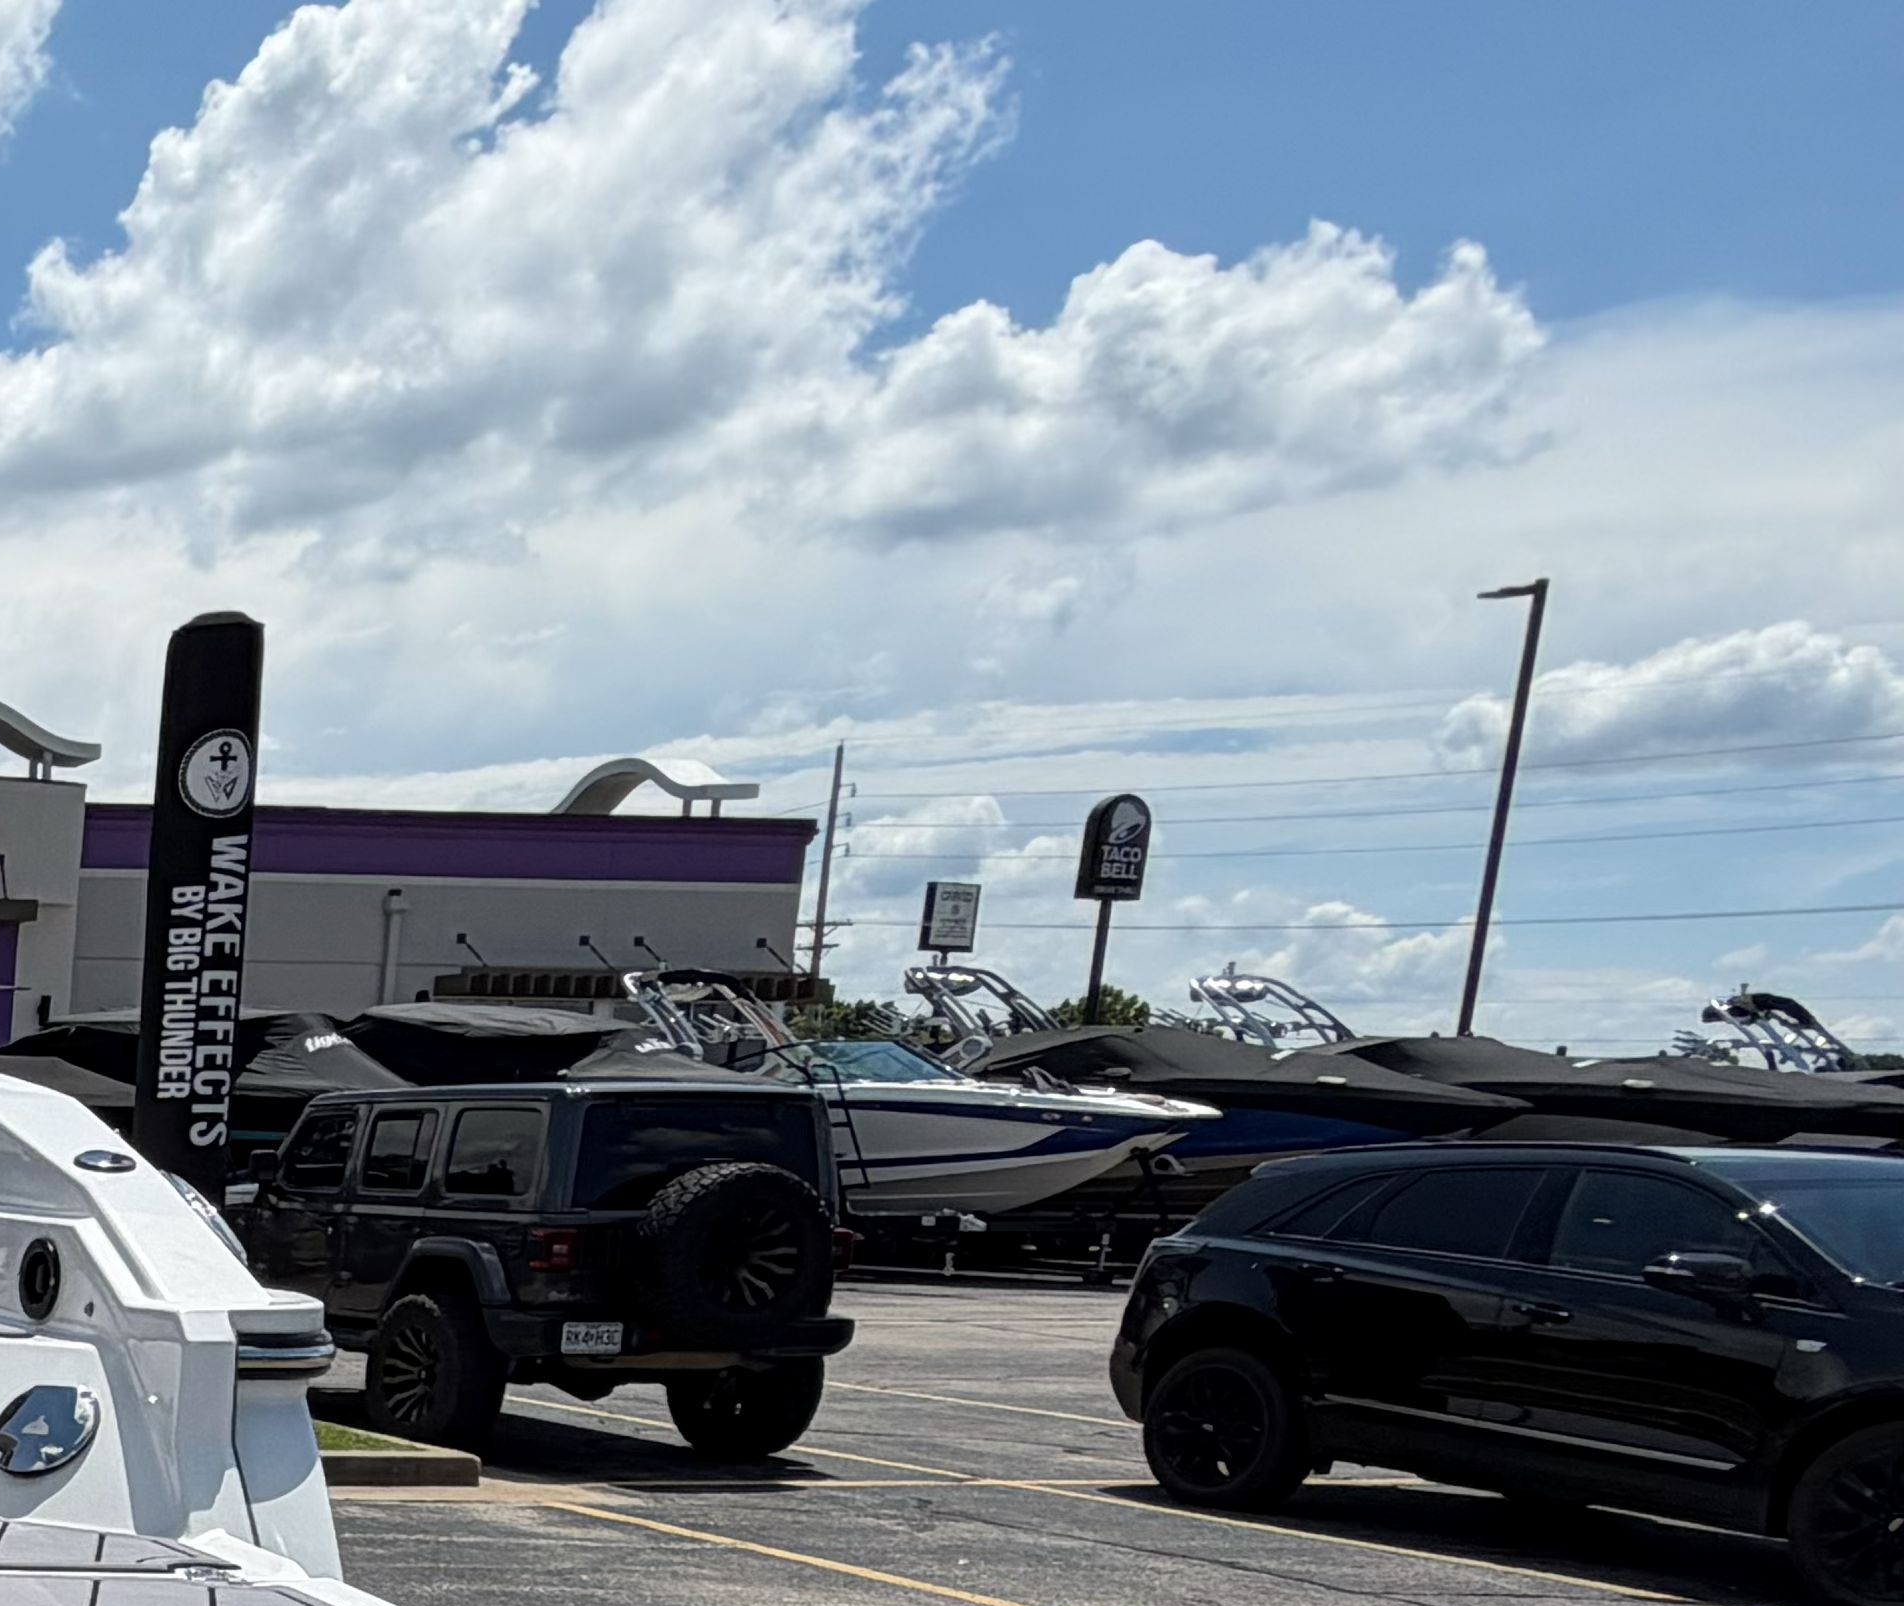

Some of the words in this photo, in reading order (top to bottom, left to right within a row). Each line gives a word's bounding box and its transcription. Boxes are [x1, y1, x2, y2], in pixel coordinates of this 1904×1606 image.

[1099, 862, 1139, 880] BELL
[1100, 844, 1142, 862] TACO
[170, 885, 206, 920] BY
[204, 834, 249, 957] WAKE
[166, 927, 203, 971] BIG
[156, 976, 198, 1099] THUNDER
[189, 969, 239, 1147] EFFECTS
